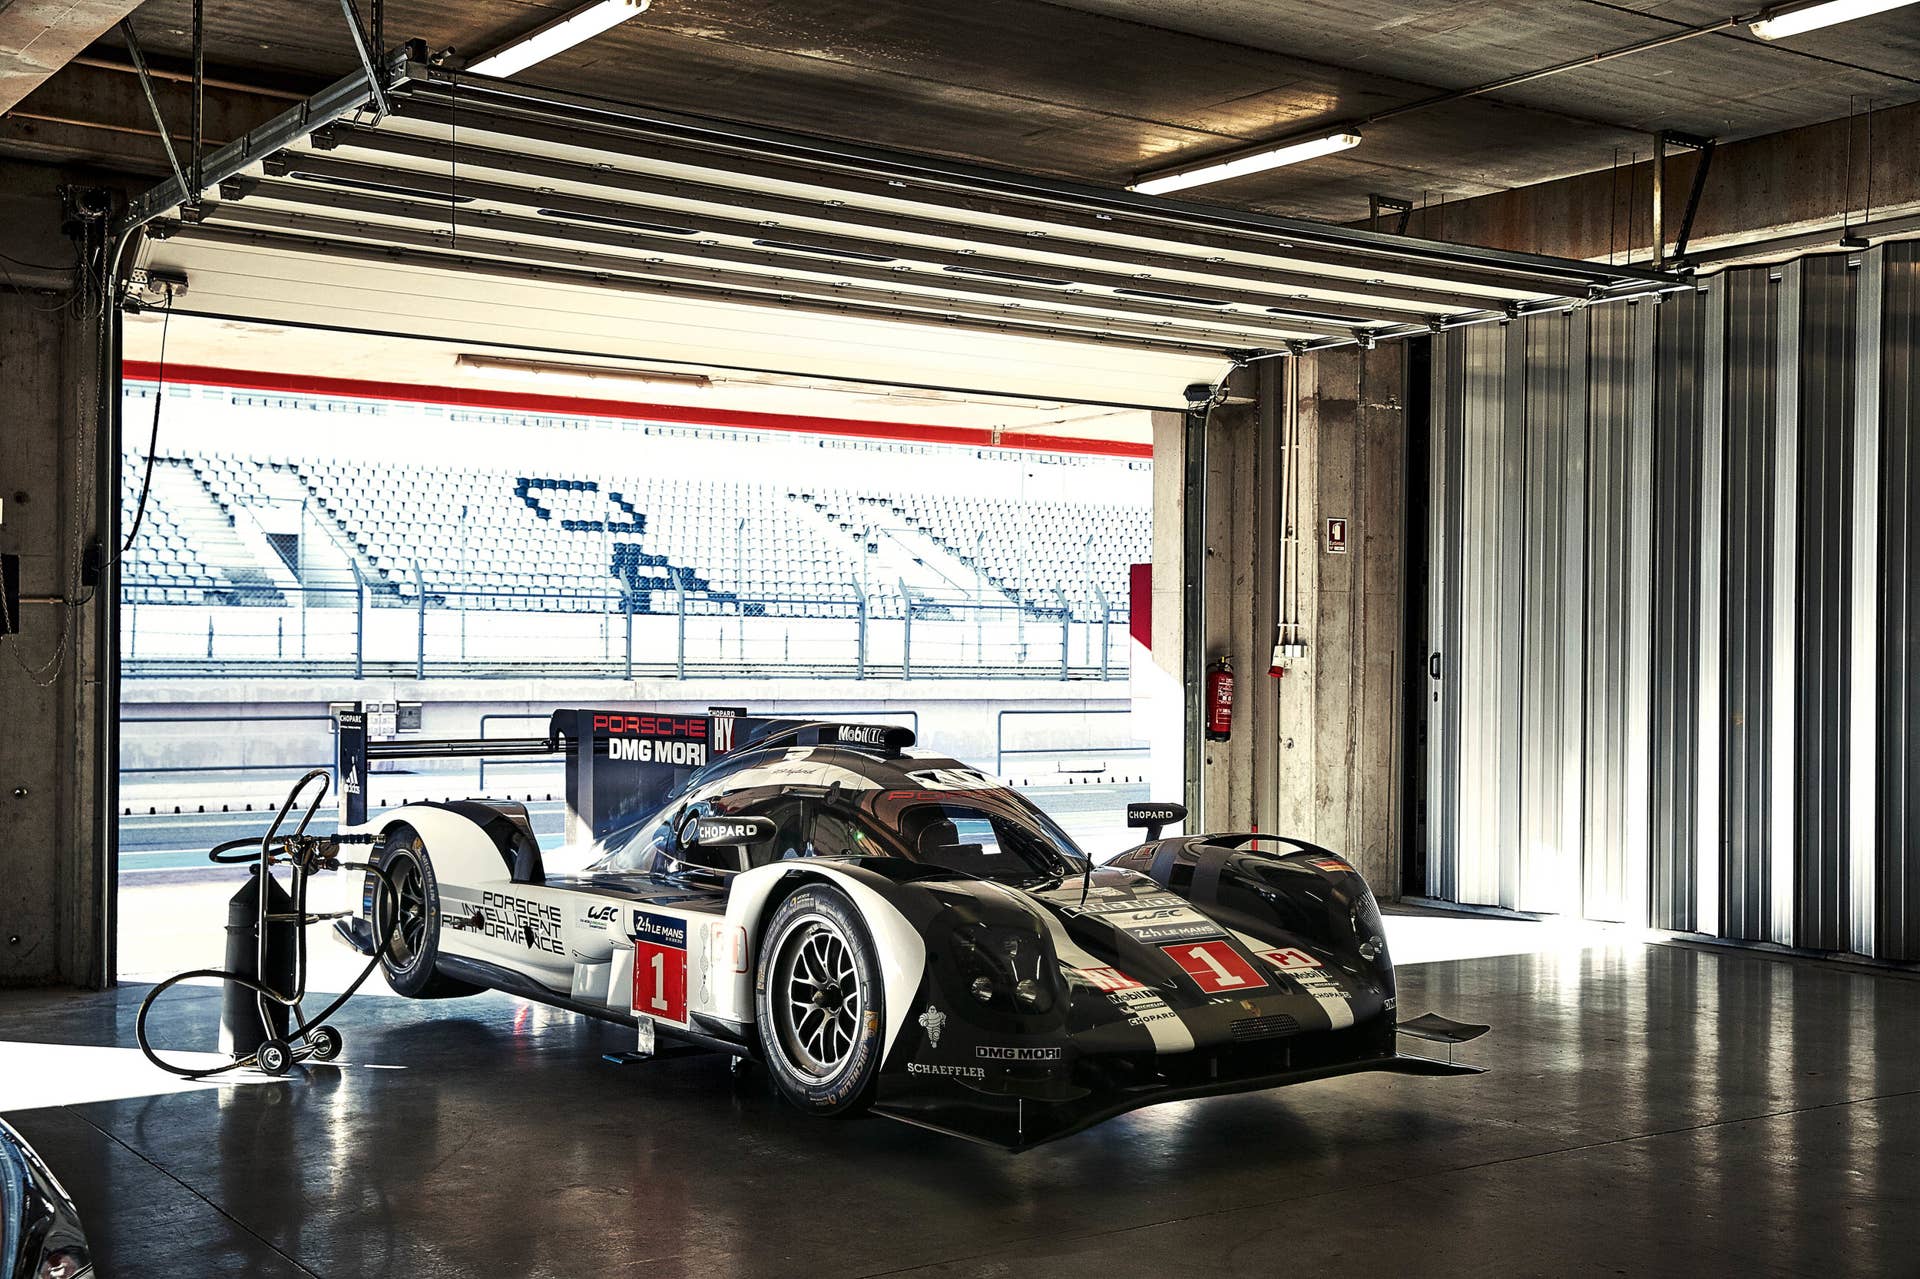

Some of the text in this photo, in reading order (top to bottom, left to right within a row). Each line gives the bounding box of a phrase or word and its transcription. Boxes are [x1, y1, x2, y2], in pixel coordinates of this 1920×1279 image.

[593, 715, 706, 738] PORSCHE
[714, 717, 735, 752] HY
[838, 725, 870, 743] Mobil
[608, 737, 706, 767] DMG MORI
[1128, 810, 1174, 819] CHOPARD
[699, 824, 758, 838] CHOPARD
[421, 854, 435, 902] MICHELIN
[483, 891, 562, 924] PORSCHE
[587, 905, 619, 923] WEC
[1131, 909, 1184, 921] WEC
[651, 924, 661, 935] LE
[661, 927, 685, 940] MANS
[1178, 925, 1216, 935] MANS
[1187, 946, 1246, 987] 1
[1264, 950, 1314, 966] P1
[650, 952, 669, 1012] 1
[1105, 991, 1146, 1005] Mobil
[1128, 1012, 1177, 1026] CHOPARD
[976, 1047, 1060, 1059] DMG MORI
[838, 1043, 869, 1098] MICHELIN
[907, 1062, 985, 1078] SCHAEFFLER
